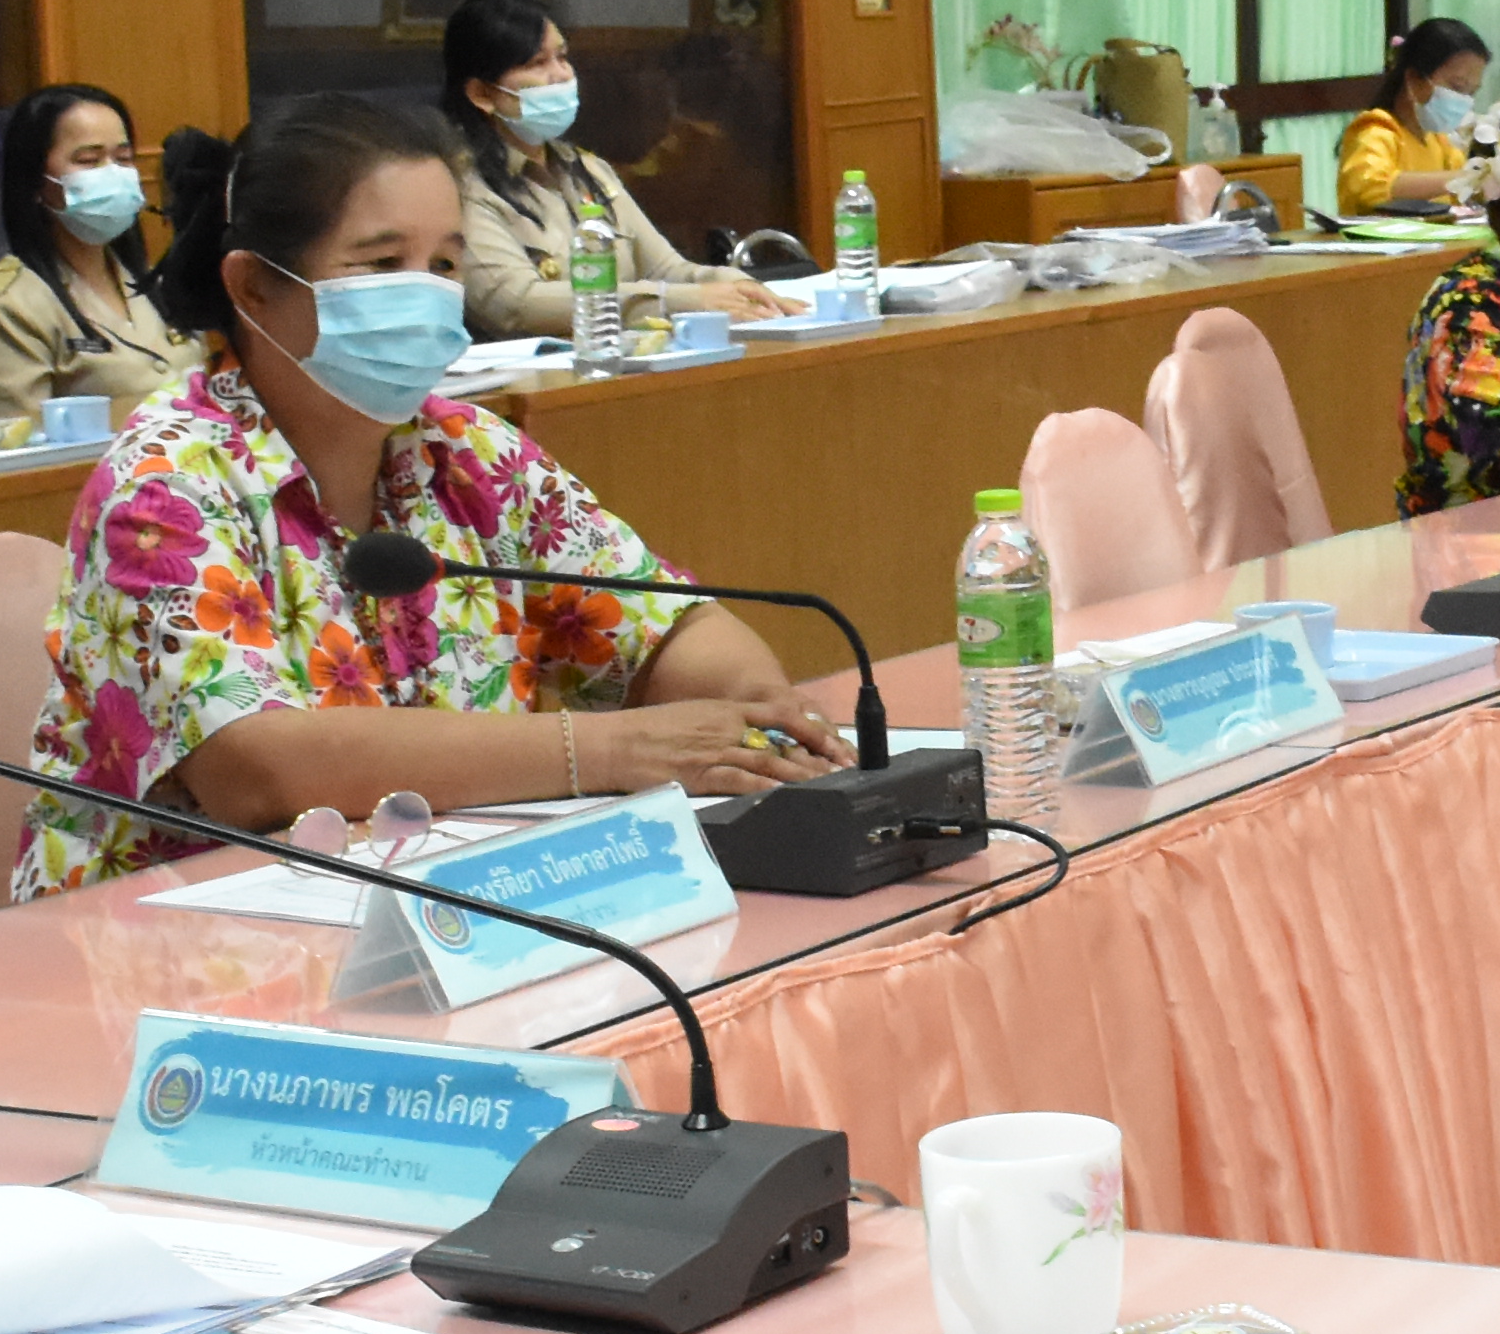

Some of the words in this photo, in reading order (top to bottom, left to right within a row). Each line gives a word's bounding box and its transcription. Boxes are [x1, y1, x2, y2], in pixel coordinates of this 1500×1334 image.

[211, 1065, 375, 1114] นางนภาพร
[386, 1074, 514, 1130] พลโคตร
